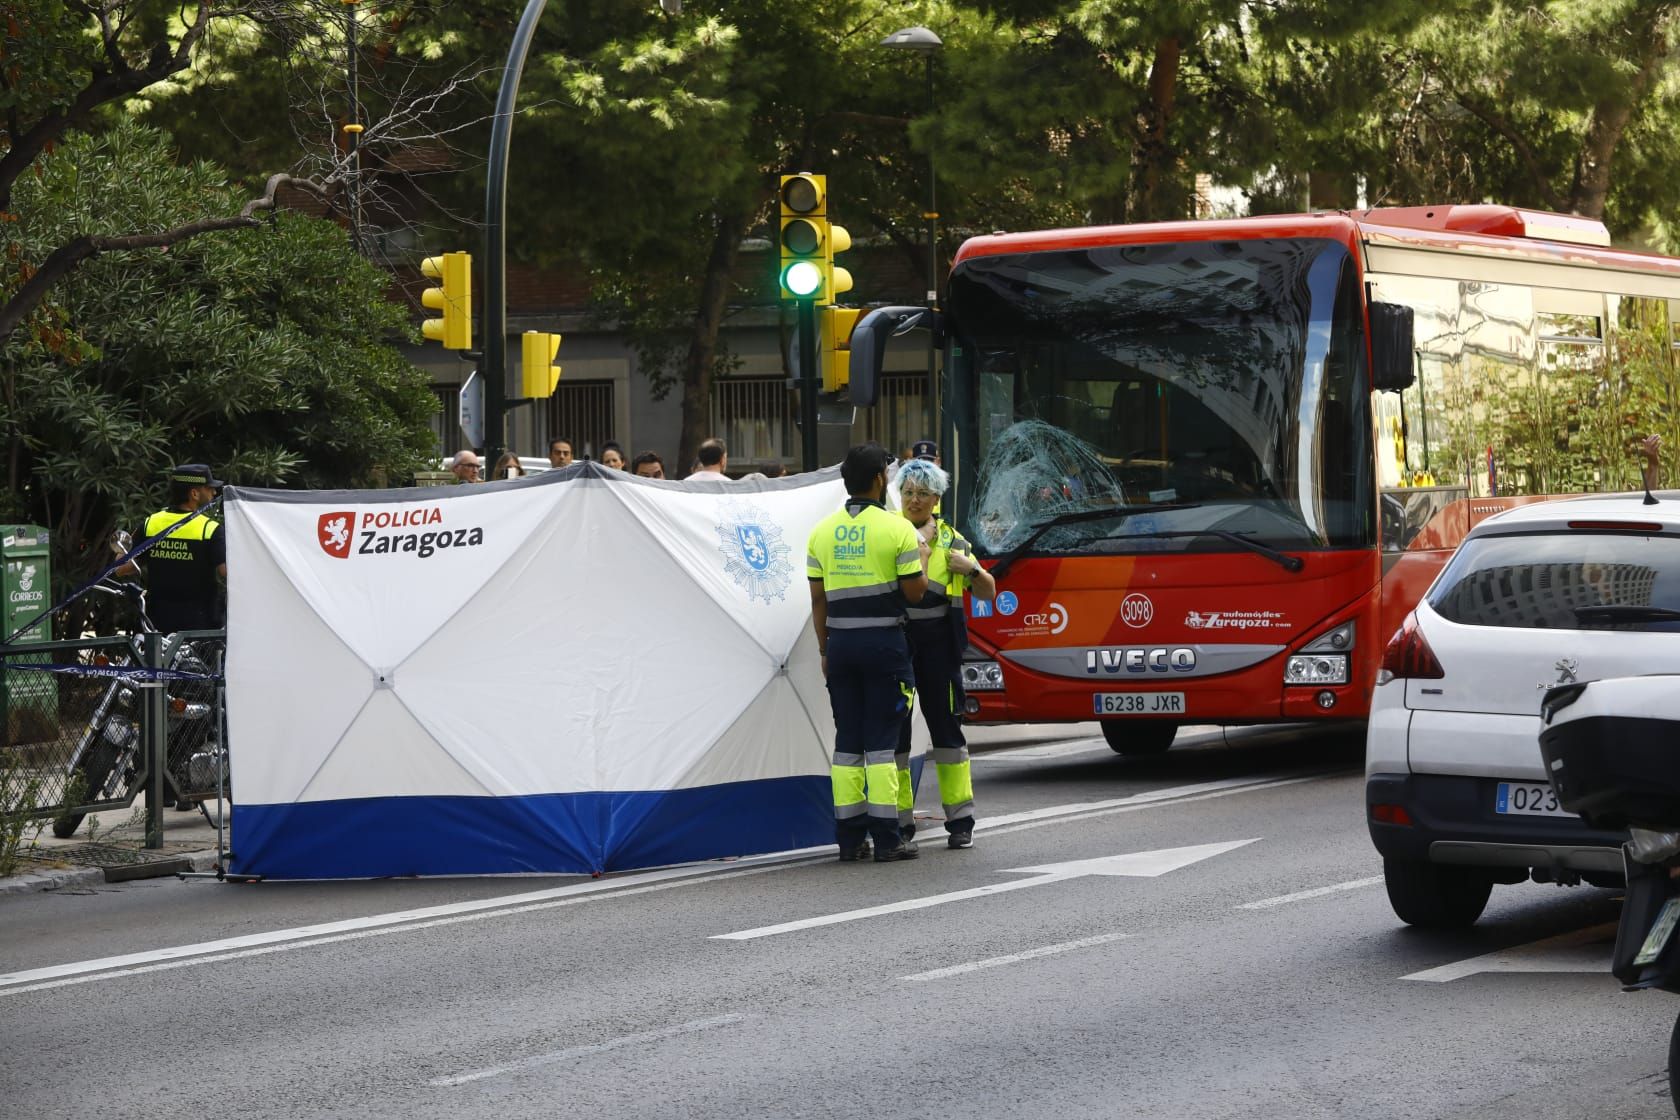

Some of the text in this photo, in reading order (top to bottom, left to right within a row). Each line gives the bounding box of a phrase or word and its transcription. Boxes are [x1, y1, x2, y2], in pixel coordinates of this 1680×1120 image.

[362, 508, 442, 528] POLICIA
[359, 527, 483, 558] Zaragoza
[834, 524, 866, 542] 061
[150, 550, 193, 561] ZARAGOZA
[156, 541, 188, 551] POLICIA
[833, 542, 866, 554] salud
[1124, 599, 1150, 622] 3098
[1085, 647, 1197, 674] IVECO
[1104, 695, 1180, 711] 6238 JXR
[1514, 787, 1559, 812] 023
